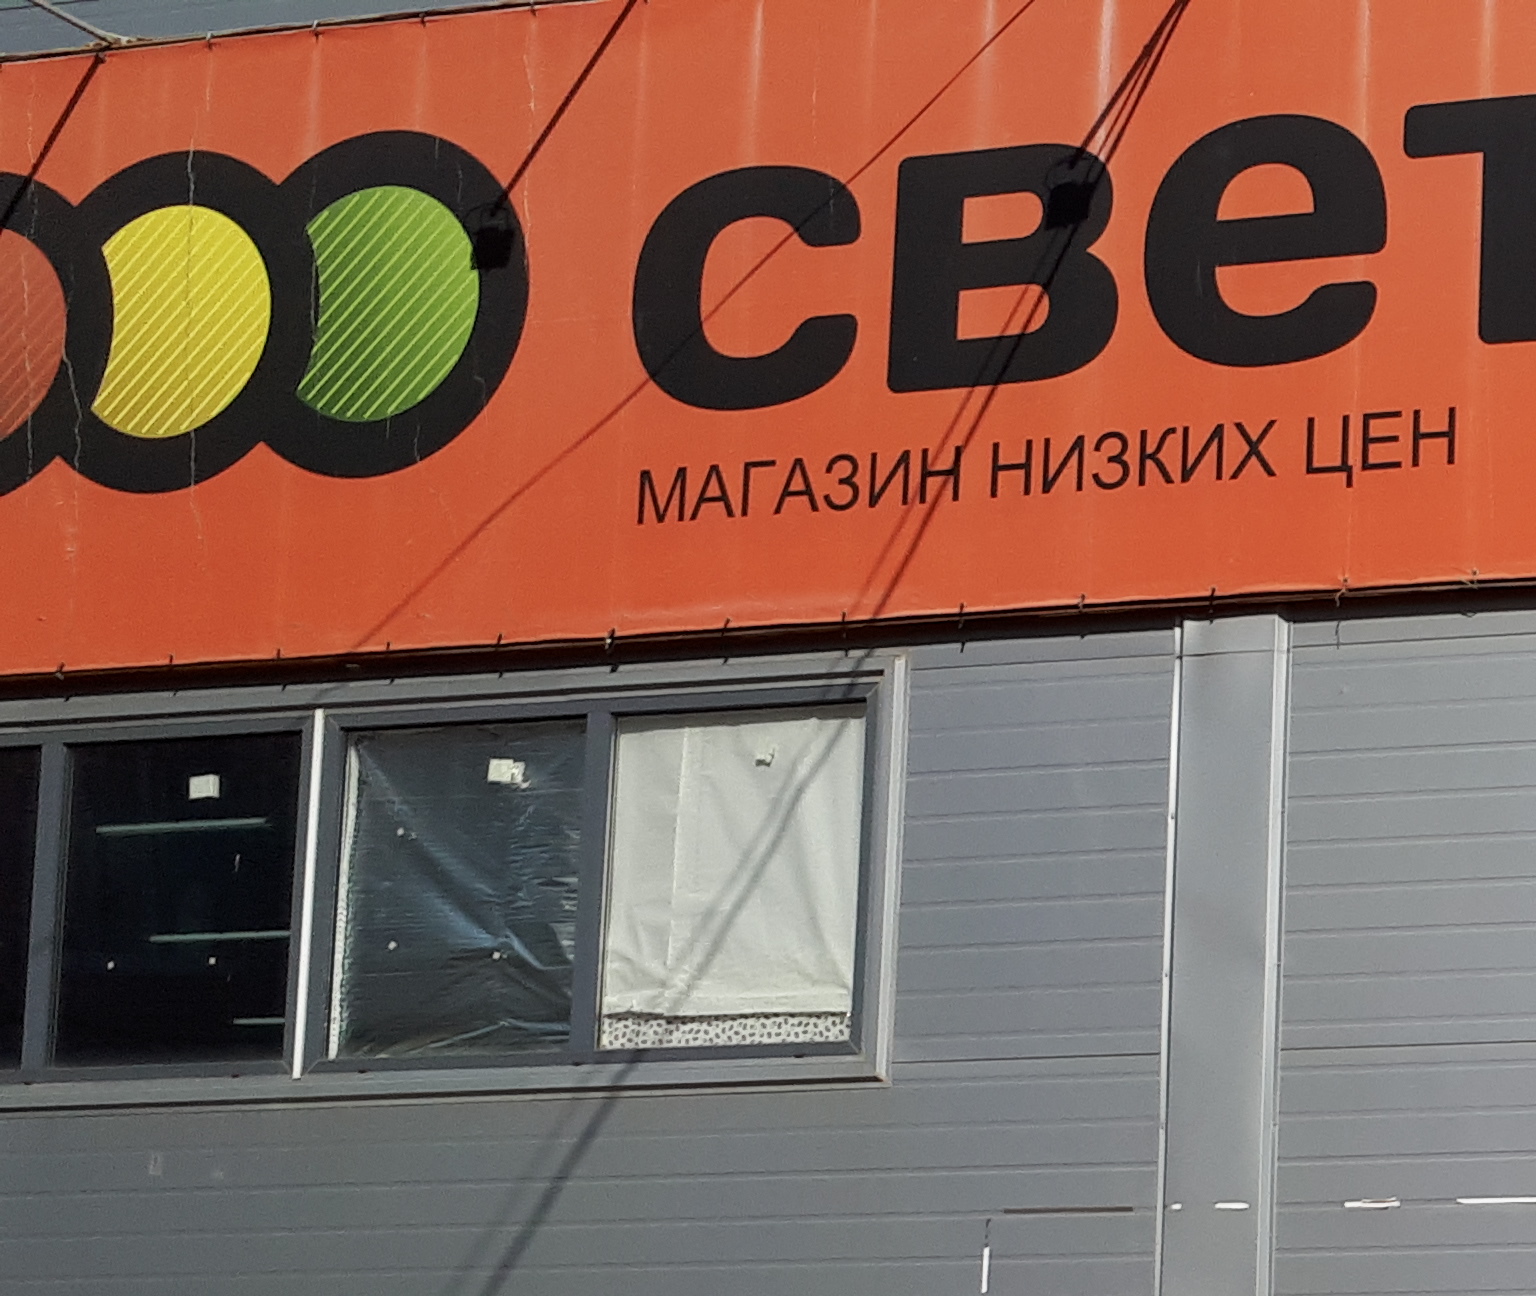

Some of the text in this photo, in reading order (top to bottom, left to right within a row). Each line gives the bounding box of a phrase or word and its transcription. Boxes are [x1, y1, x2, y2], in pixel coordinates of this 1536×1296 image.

[636, 406, 1458, 525] МАГАЗИН НИЗКИХ ЦЕН
